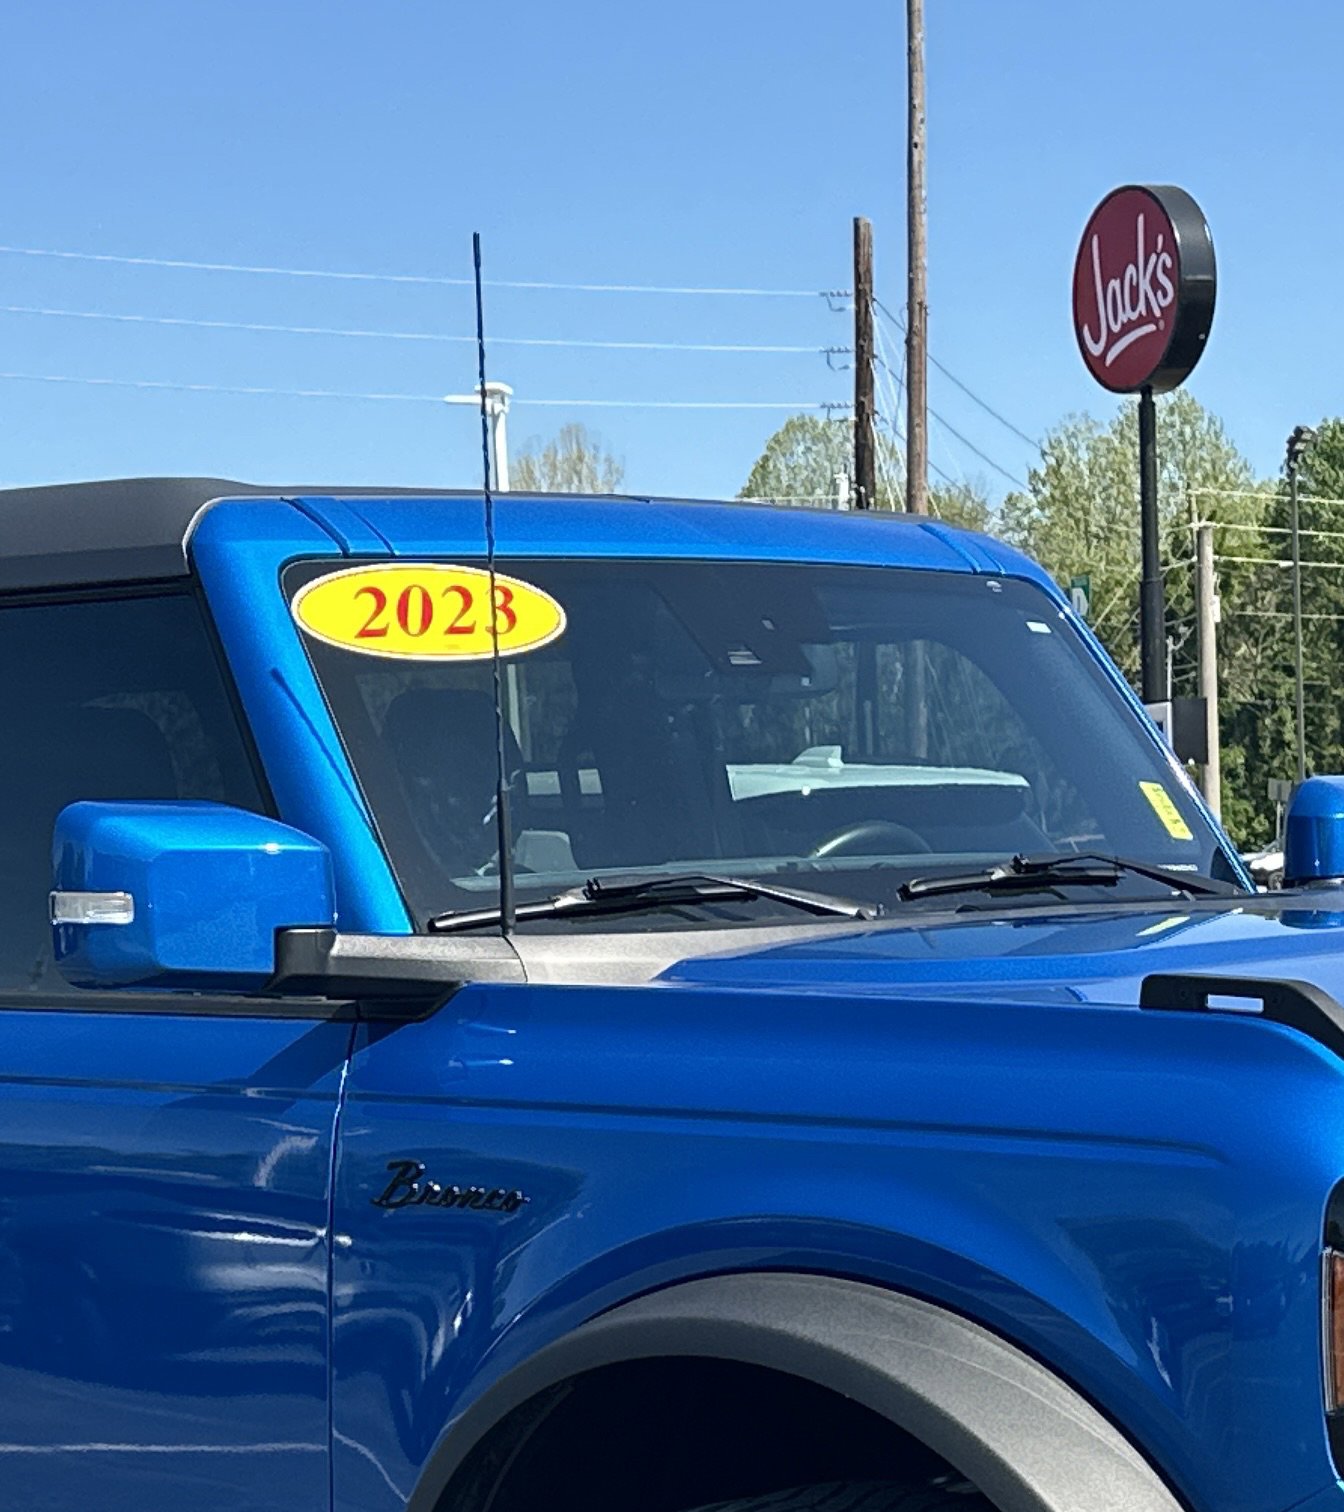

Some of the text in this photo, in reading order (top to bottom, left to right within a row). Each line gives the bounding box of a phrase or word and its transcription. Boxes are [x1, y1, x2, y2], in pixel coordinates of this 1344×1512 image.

[1082, 212, 1175, 357] Jack's
[353, 583, 518, 639] 2023
[370, 1159, 532, 1213] Bronco
